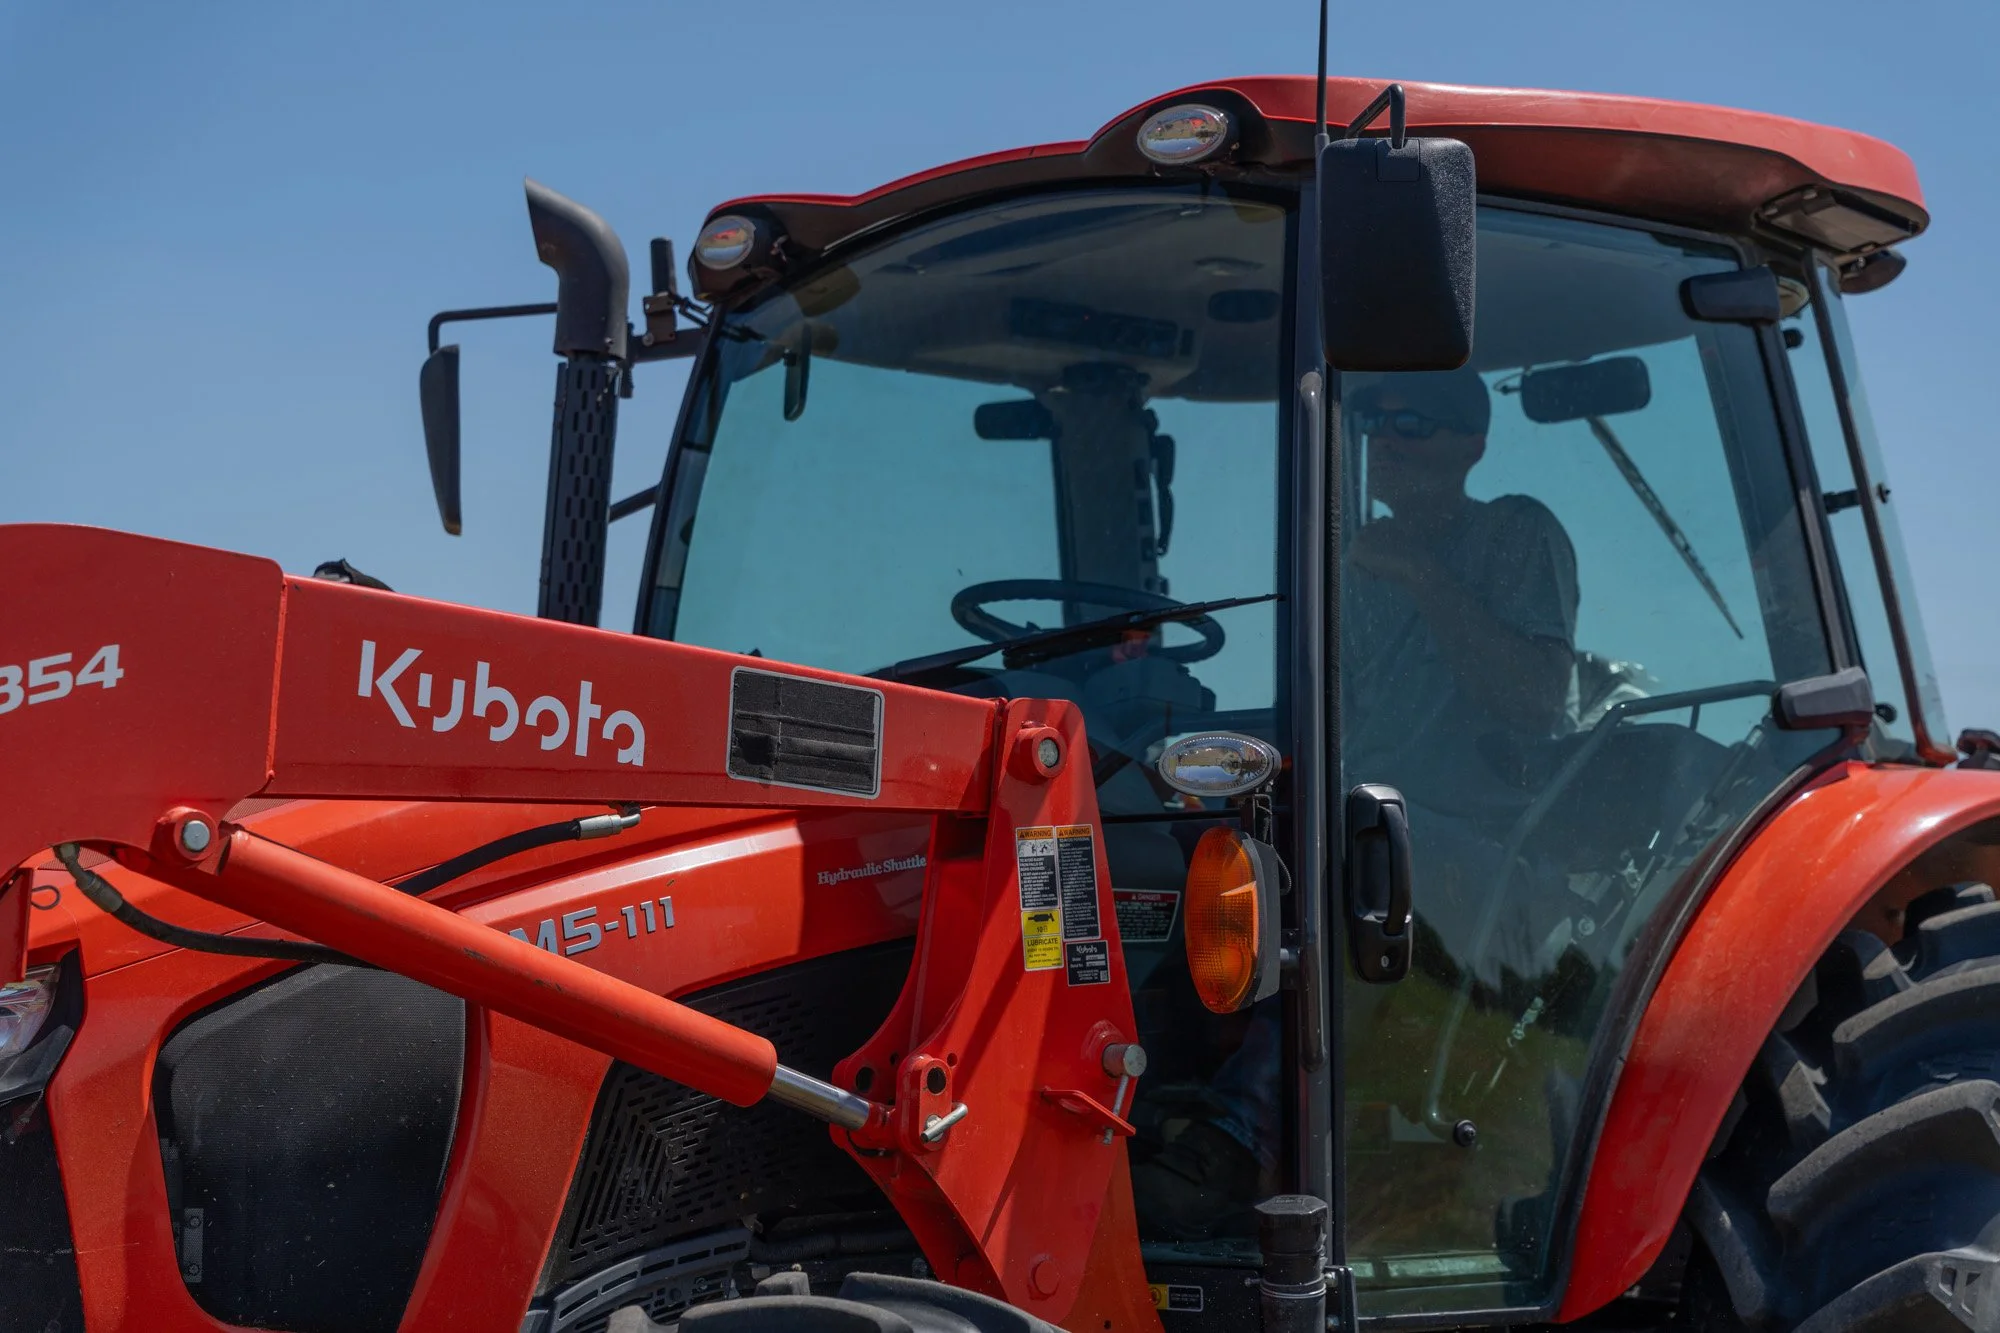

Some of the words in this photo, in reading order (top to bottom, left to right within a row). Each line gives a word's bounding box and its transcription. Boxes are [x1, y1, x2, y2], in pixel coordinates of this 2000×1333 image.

[357, 639, 646, 766] Kubota
[1024, 830, 1052, 838] WARNING
[1063, 828, 1090, 837] WARNING
[817, 863, 882, 886] Hydraulic
[883, 855, 927, 873] Shuttle
[1137, 893, 1161, 901] DANGER
[508, 896, 675, 957] M5-111
[1027, 937, 1058, 946] LUBRICATE
[1076, 945, 1098, 953] Kubota
